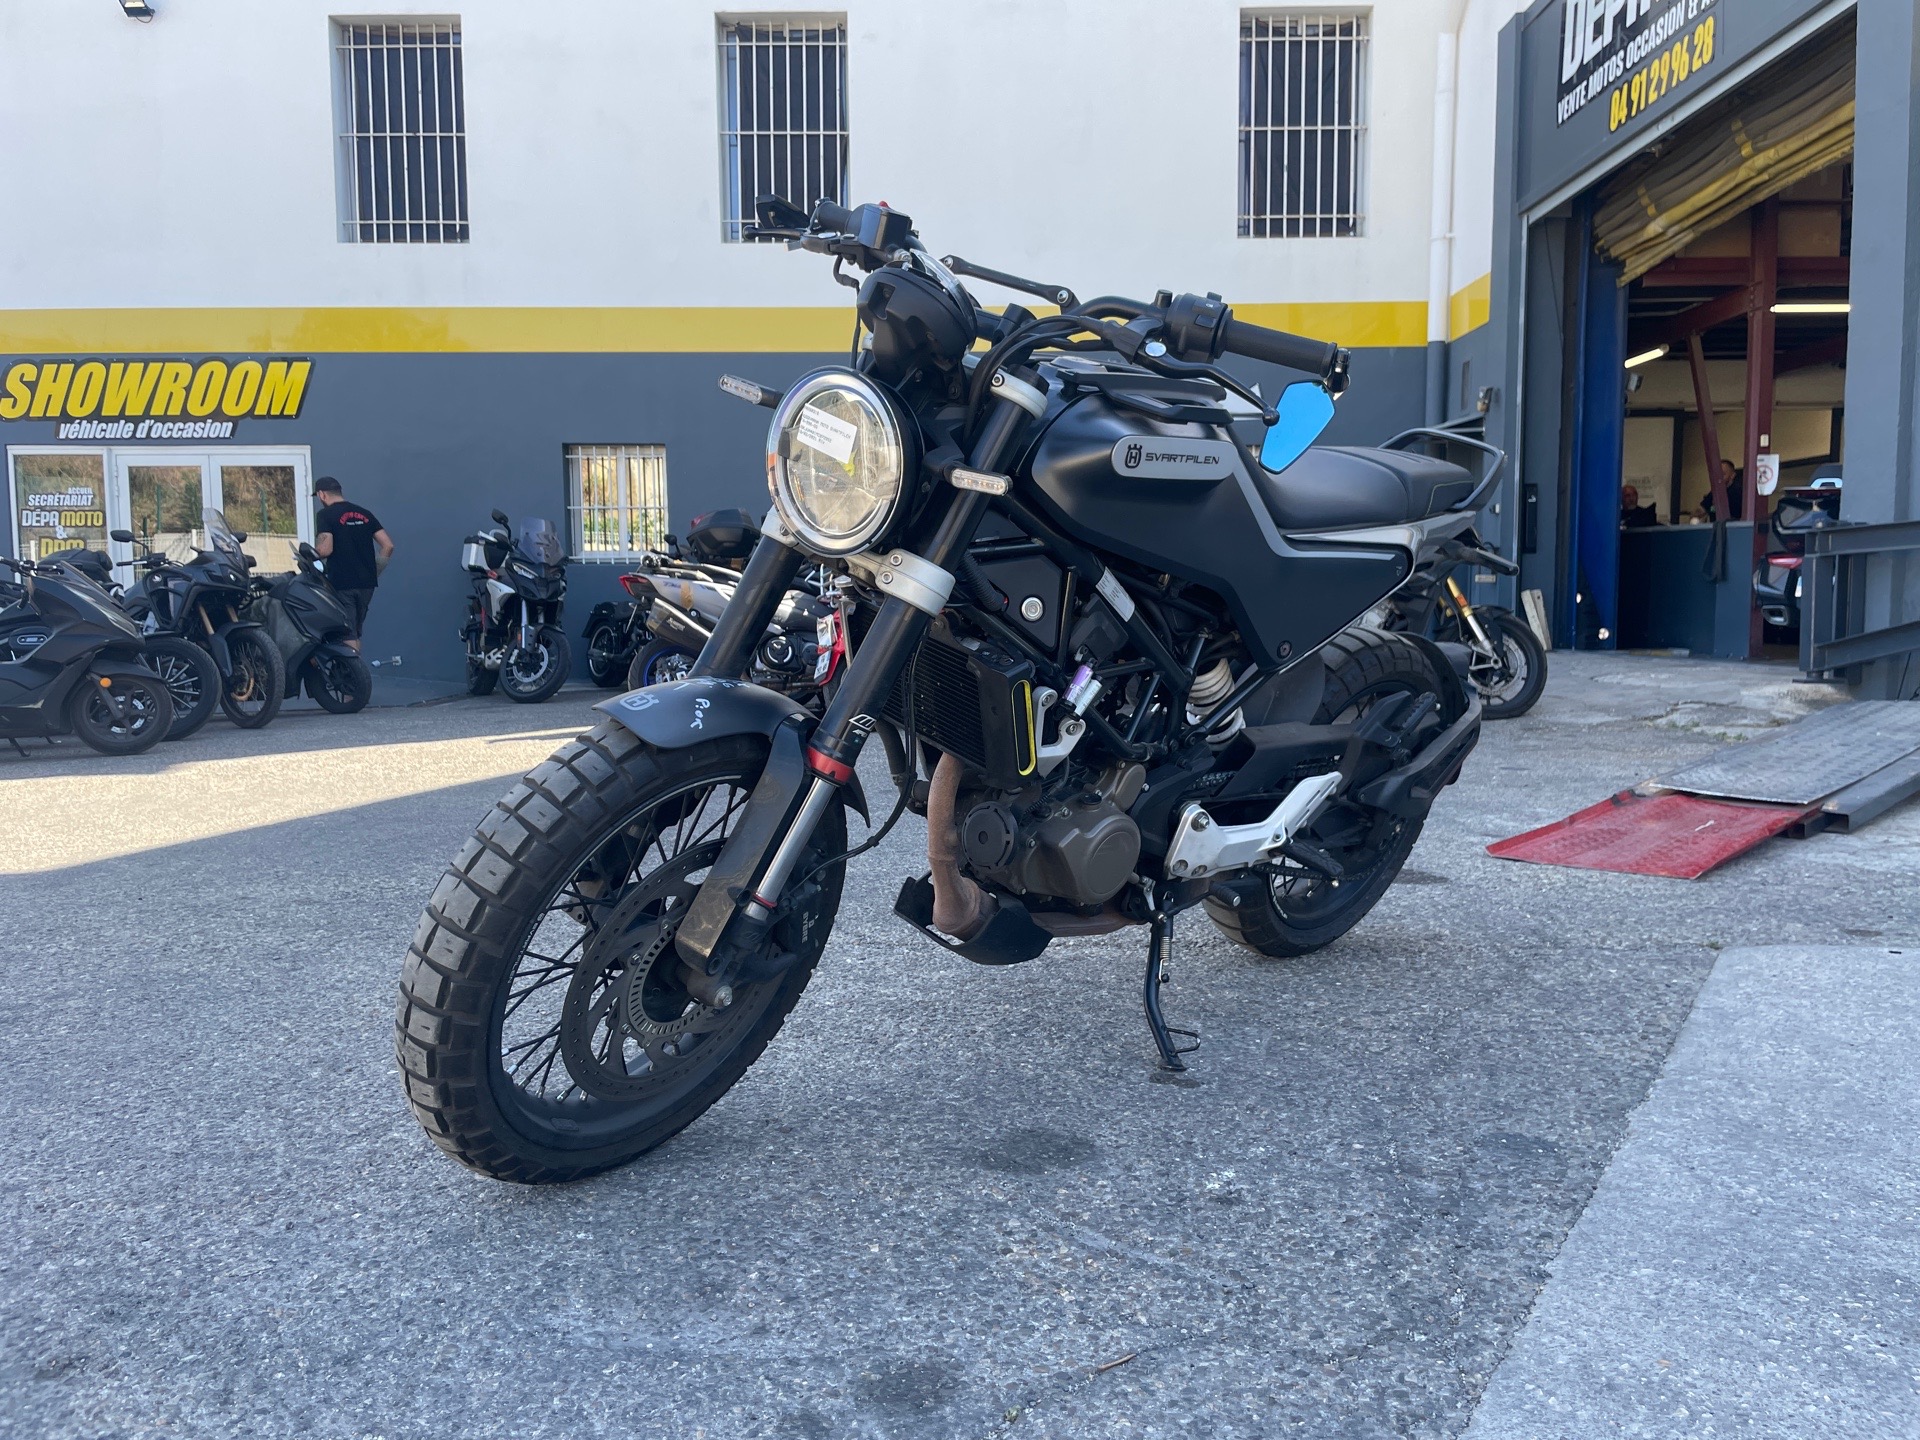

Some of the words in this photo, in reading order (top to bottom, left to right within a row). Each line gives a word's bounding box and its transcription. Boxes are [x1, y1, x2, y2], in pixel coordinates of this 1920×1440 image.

[1557, 79, 1588, 125] VENTE
[1588, 50, 1625, 100] MOTOS
[1625, 4, 1686, 70] OCCASION
[0, 360, 312, 419] SHOWROOM
[59, 419, 134, 439] véhicule
[135, 419, 234, 439] d'occasion
[1144, 452, 1220, 465] SVARTPILEN
[67, 487, 93, 495] ACCUEIL
[27, 493, 94, 507] SECRÉTARIAT
[55, 525, 68, 539] &
